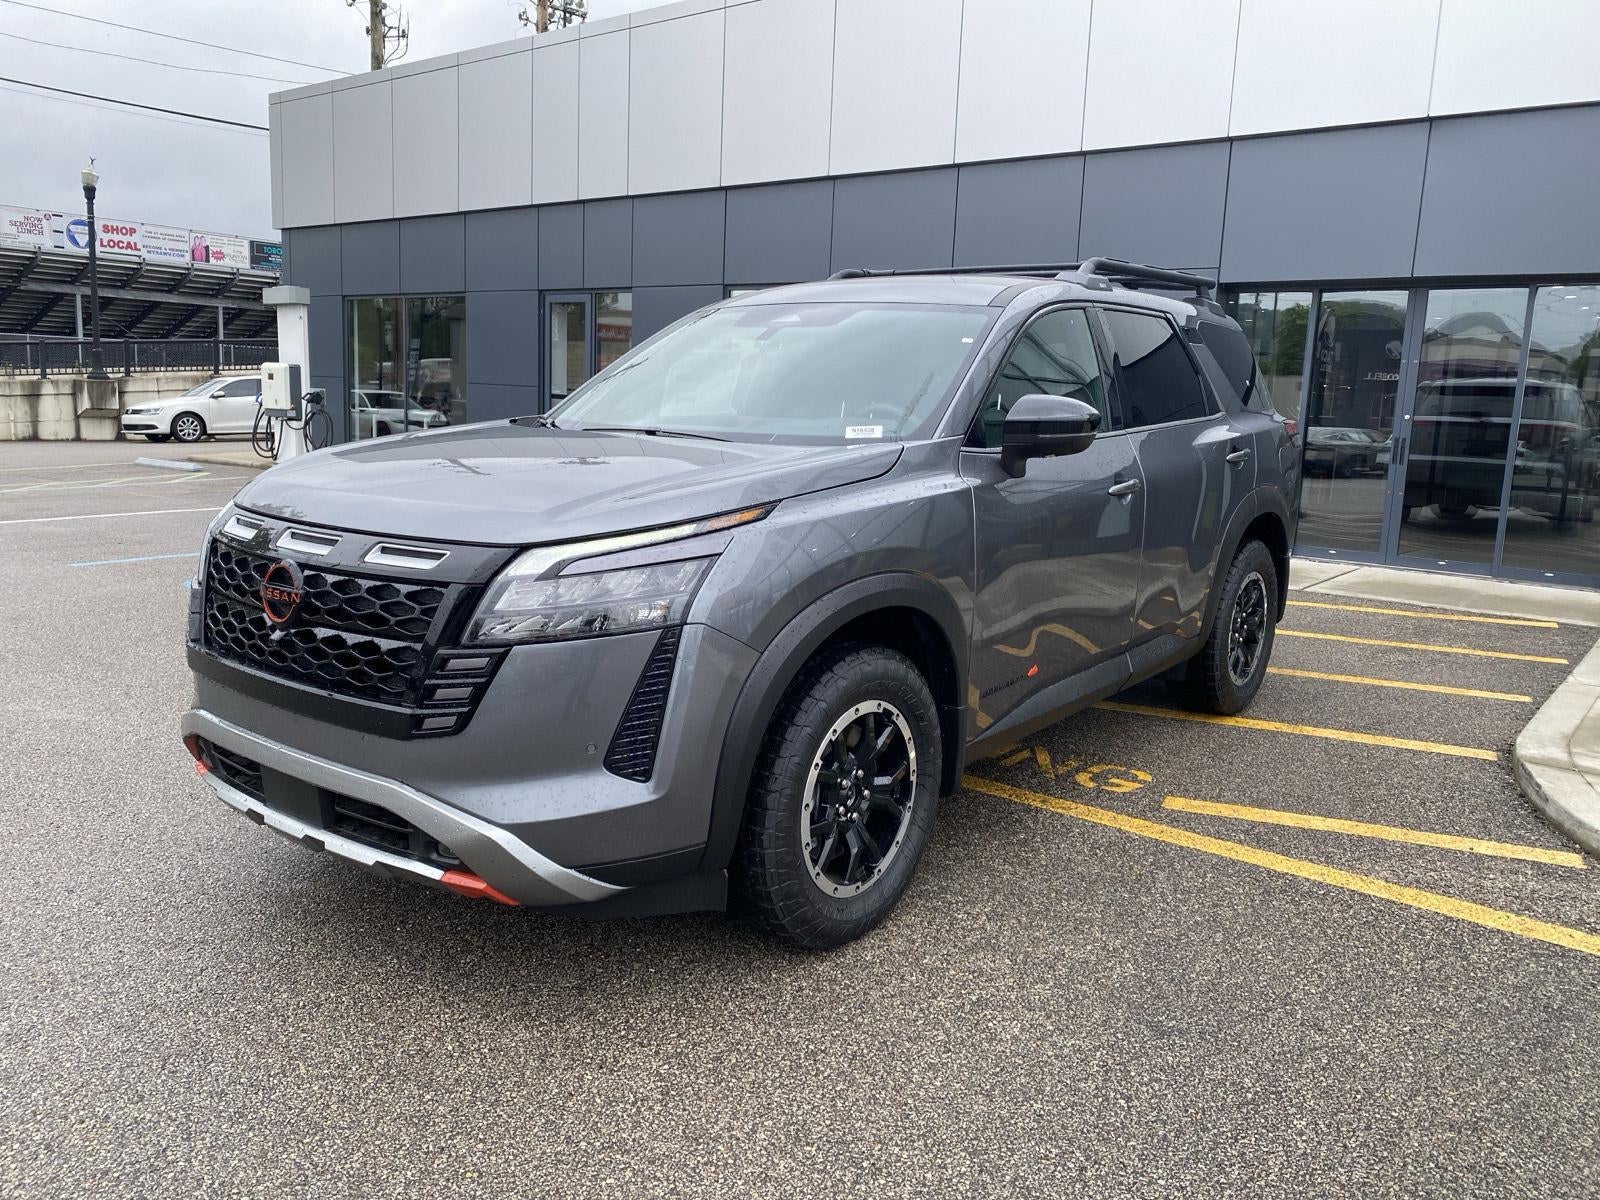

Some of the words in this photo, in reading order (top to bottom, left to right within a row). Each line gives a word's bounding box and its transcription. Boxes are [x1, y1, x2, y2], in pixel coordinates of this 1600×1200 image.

[23, 215, 43, 223] NOW
[9, 220, 43, 230] SERVING
[102, 223, 137, 237] SHOP
[16, 227, 44, 236] LUNCH
[100, 238, 141, 252] LOCAL
